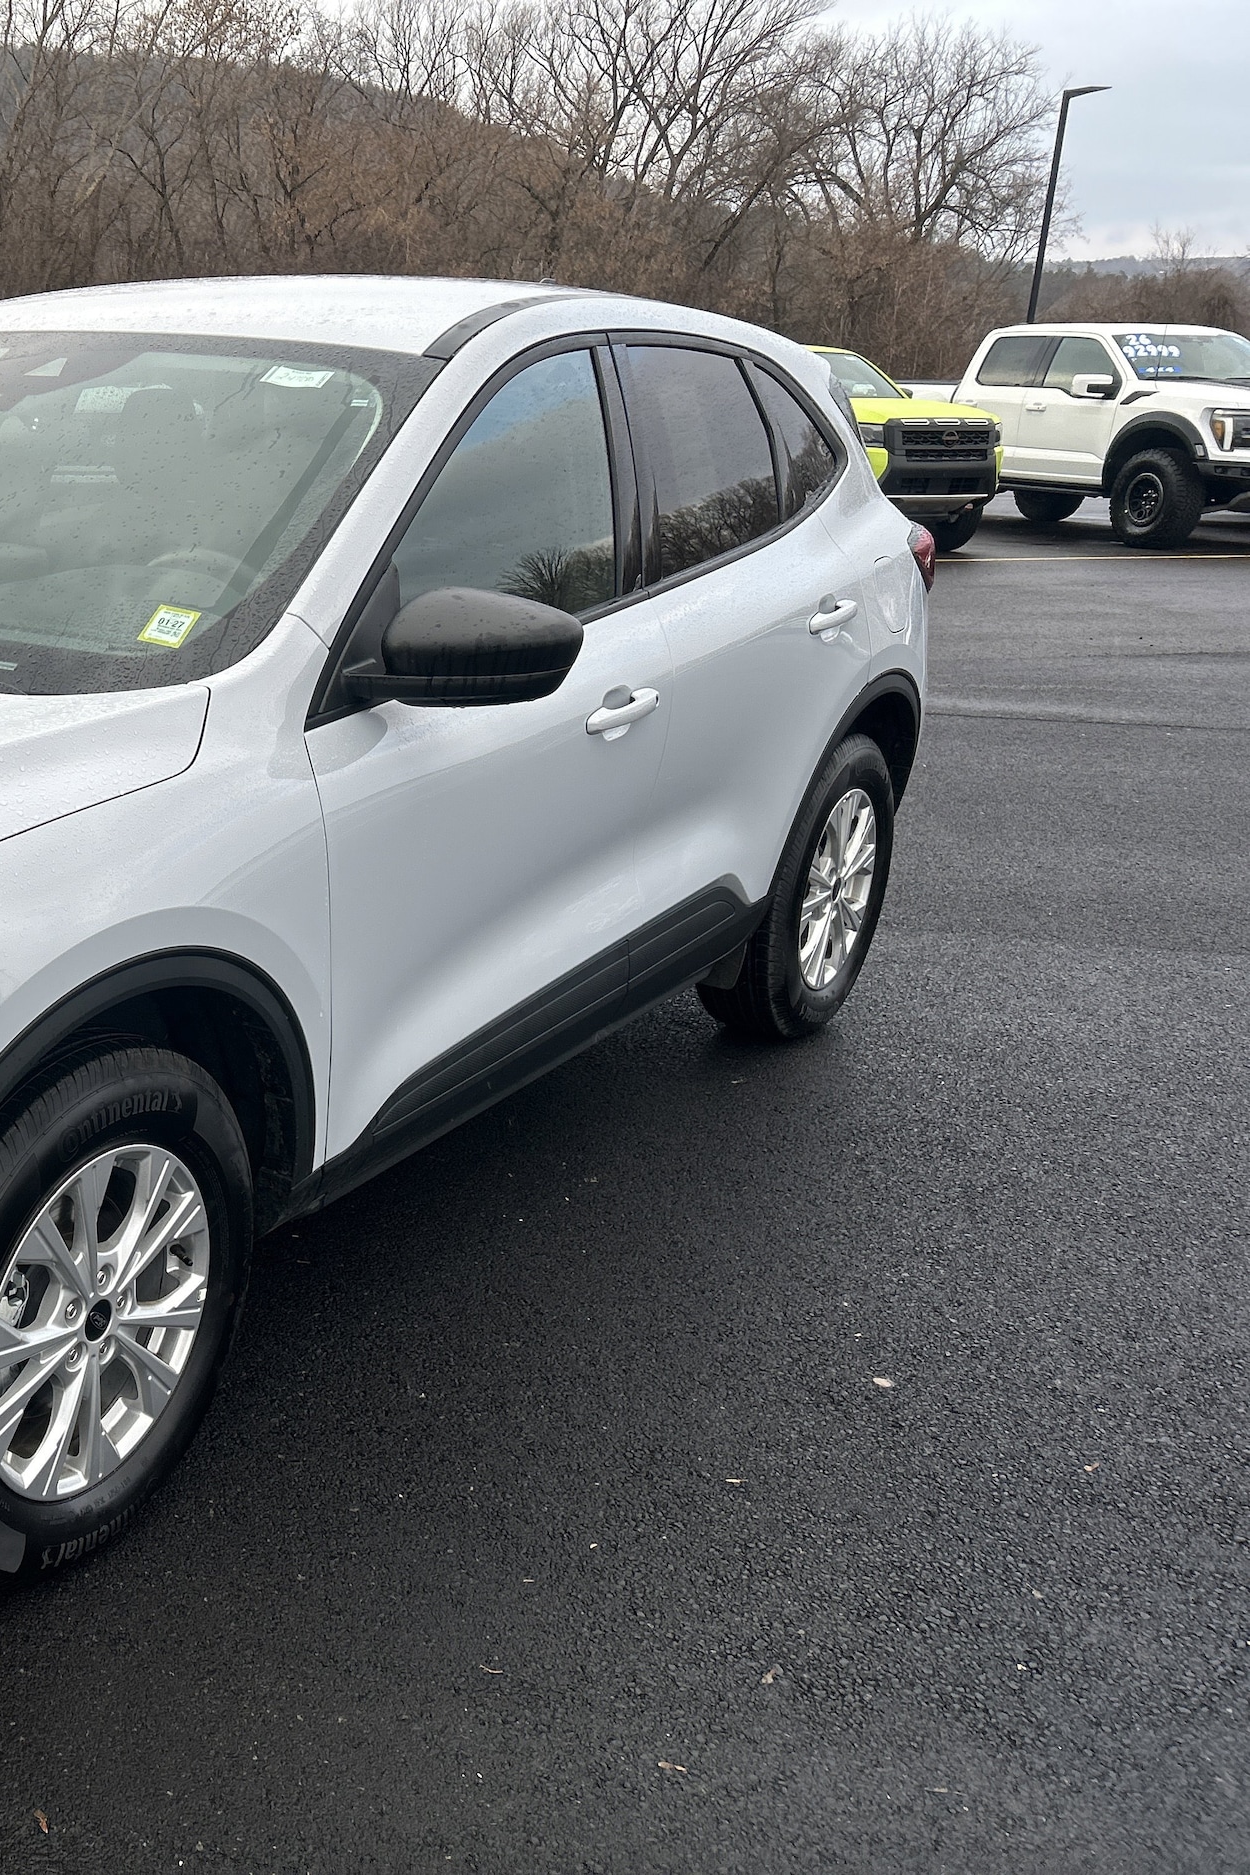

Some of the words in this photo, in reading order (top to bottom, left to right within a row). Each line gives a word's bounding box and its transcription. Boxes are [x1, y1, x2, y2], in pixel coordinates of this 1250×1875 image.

[1125, 334, 1151, 345] 26
[1122, 344, 1181, 358] 92999
[58, 1089, 169, 1163] Continental
